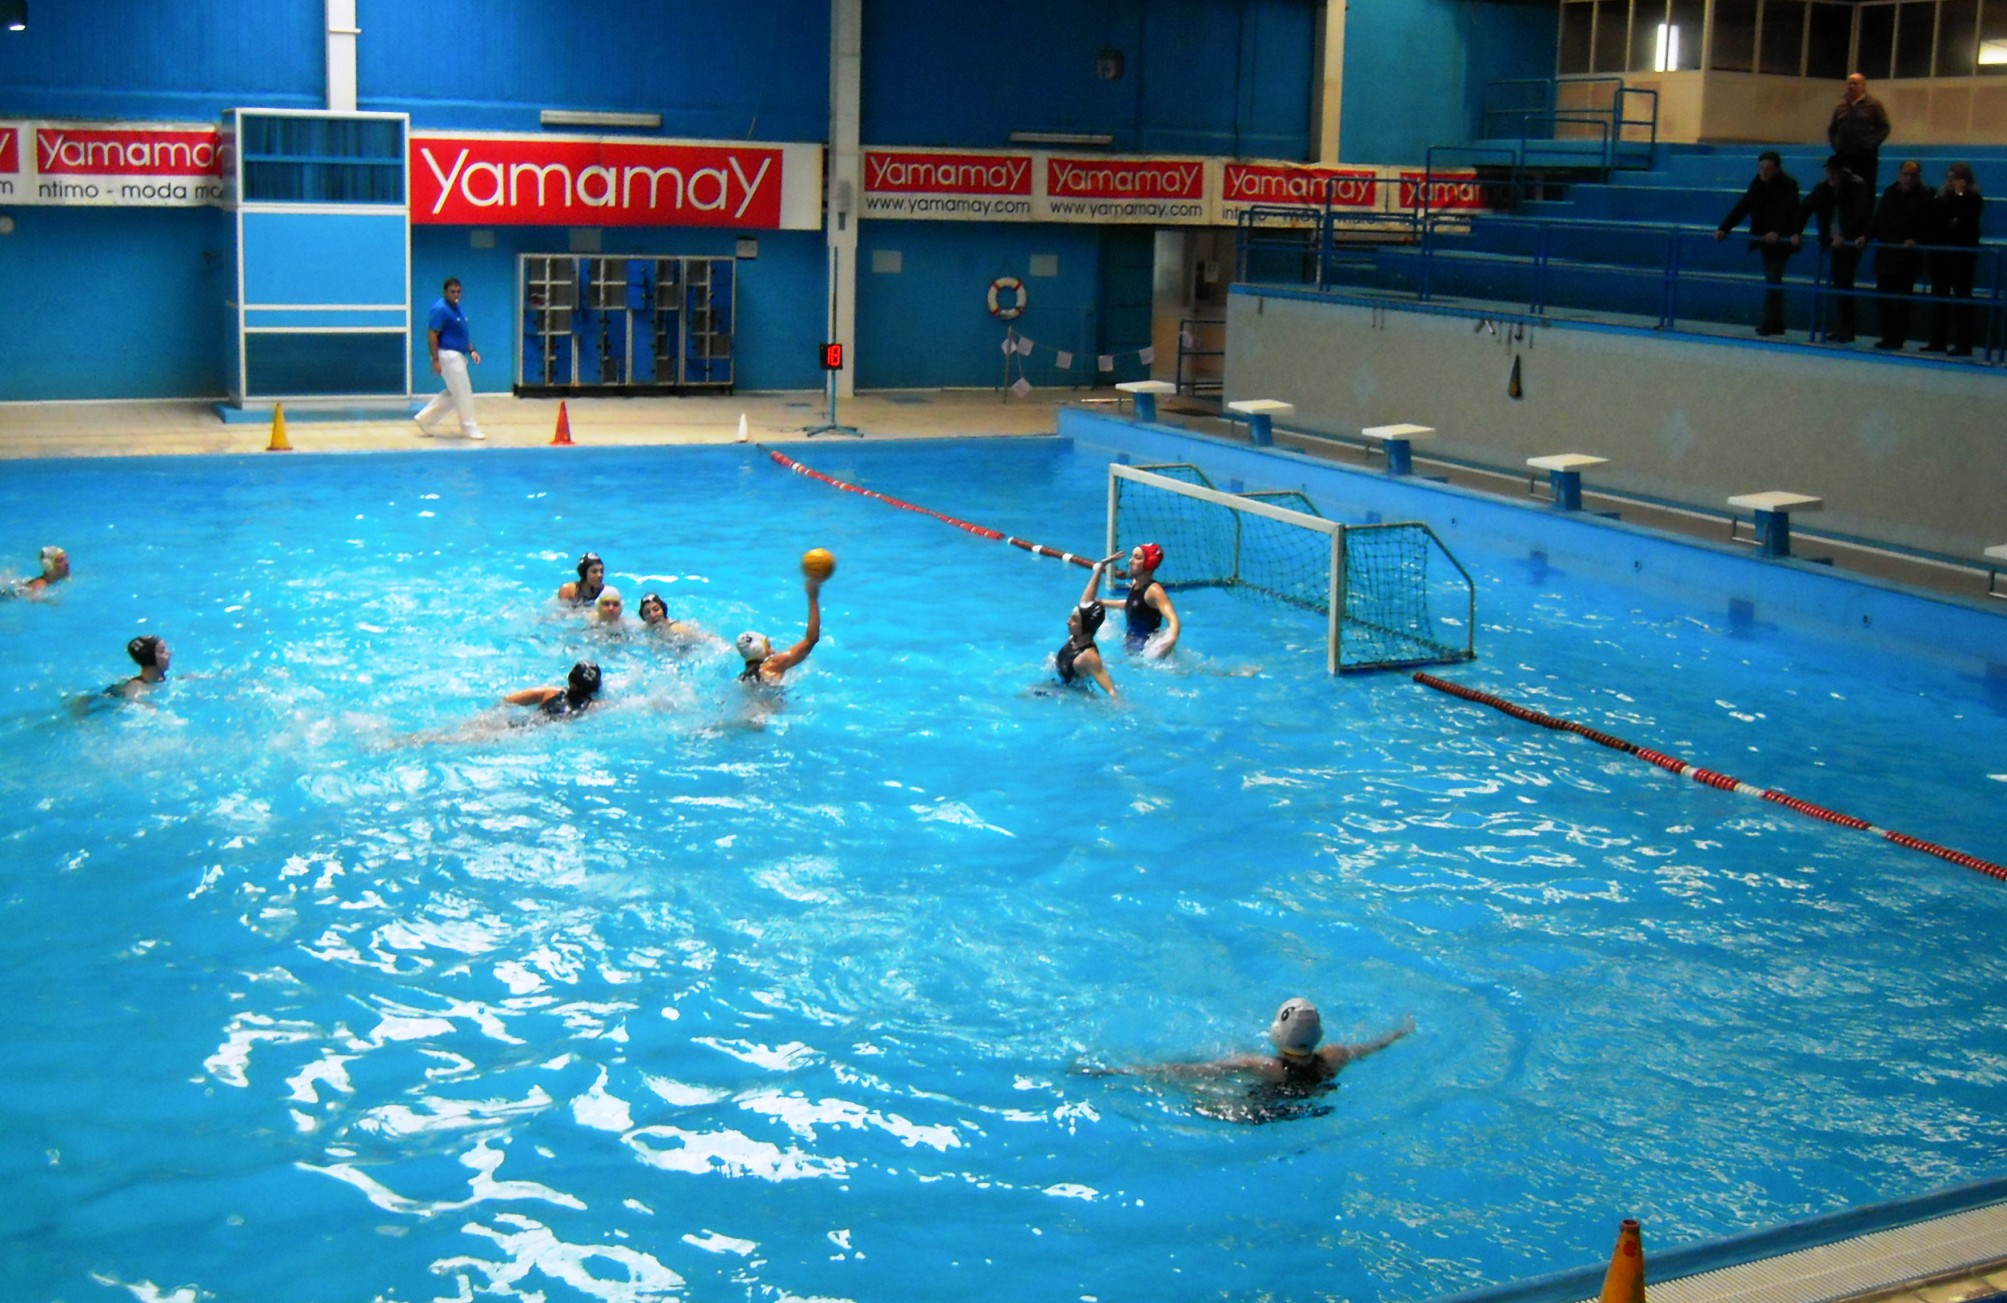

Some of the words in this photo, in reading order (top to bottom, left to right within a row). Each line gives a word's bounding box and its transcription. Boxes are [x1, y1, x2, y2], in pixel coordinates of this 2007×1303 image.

[122, 182, 187, 199] moda
[866, 198, 1030, 216] www.yamamay.com
[1050, 202, 1202, 218] www.yamamay.com
